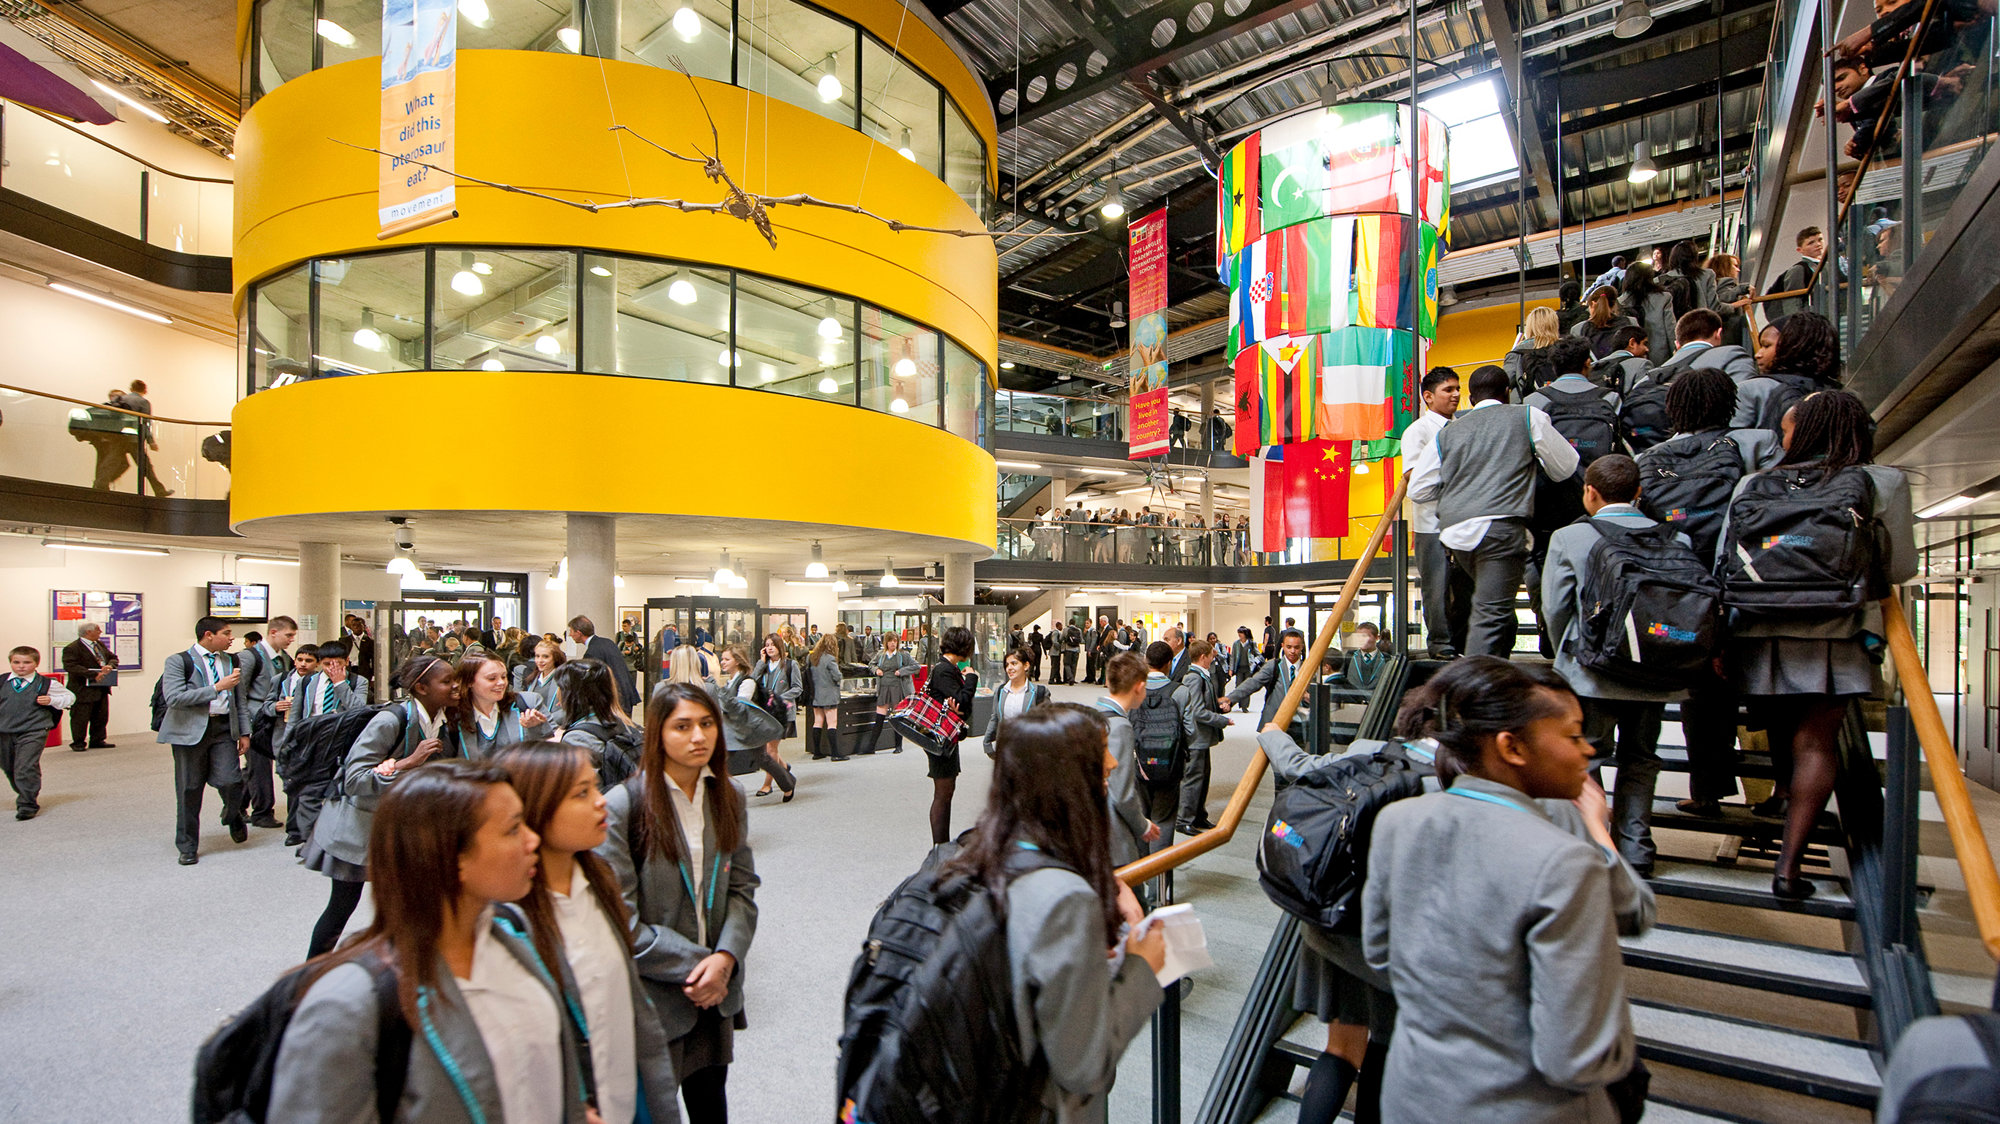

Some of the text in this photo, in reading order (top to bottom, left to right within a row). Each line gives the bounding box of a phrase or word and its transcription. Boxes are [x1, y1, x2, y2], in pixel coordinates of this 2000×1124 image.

[405, 92, 435, 116] What
[399, 115, 441, 142] did this
[392, 140, 446, 171] pterosaur
[406, 165, 429, 187] eat?
[391, 194, 444, 218] movement
[1132, 250, 1153, 264] ACADEMY
[1157, 244, 1164, 252] AN
[1134, 238, 1162, 255] THE LANGLEY
[1131, 252, 1165, 272] INTERNATIONAL
[1139, 263, 1157, 275] SCHOOL
[1151, 398, 1161, 407] you
[1138, 409, 1152, 419] lived
[1136, 428, 1161, 440] country?
[1137, 419, 1159, 430] another
